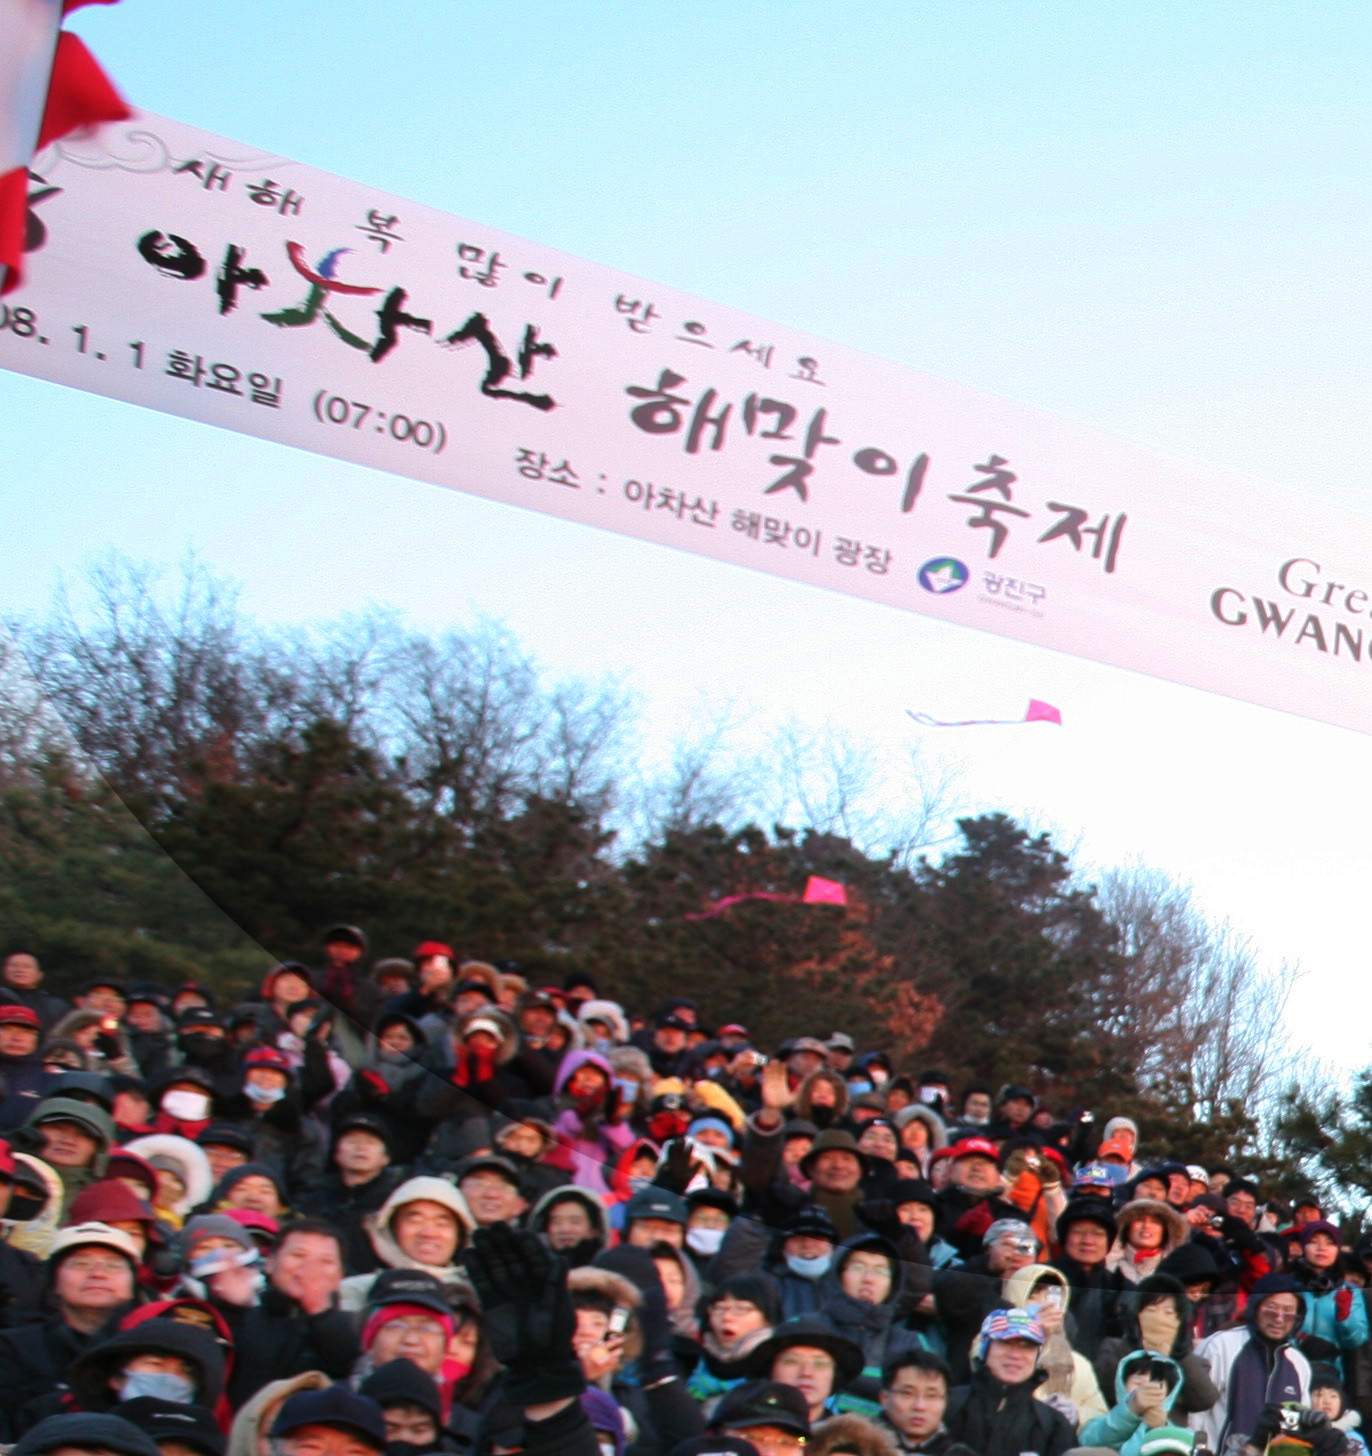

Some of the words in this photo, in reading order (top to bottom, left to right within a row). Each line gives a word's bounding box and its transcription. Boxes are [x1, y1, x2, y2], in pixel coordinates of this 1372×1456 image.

[137, 229, 560, 413] 아차산
[173, 160, 304, 215] 새해
[356, 208, 405, 253] 복
[458, 242, 564, 300] 많이
[614, 293, 827, 386] 받으세요
[73, 324, 107, 361] 1.
[129, 340, 145, 369] 1
[166, 350, 282, 410] 화요일
[313, 389, 448, 456] (07:00)
[515, 447, 581, 489] 장소
[624, 478, 722, 529] 아차산
[731, 507, 822, 558] 해맞이
[832, 535, 894, 576] 광장
[982, 571, 1047, 605] 광진구
